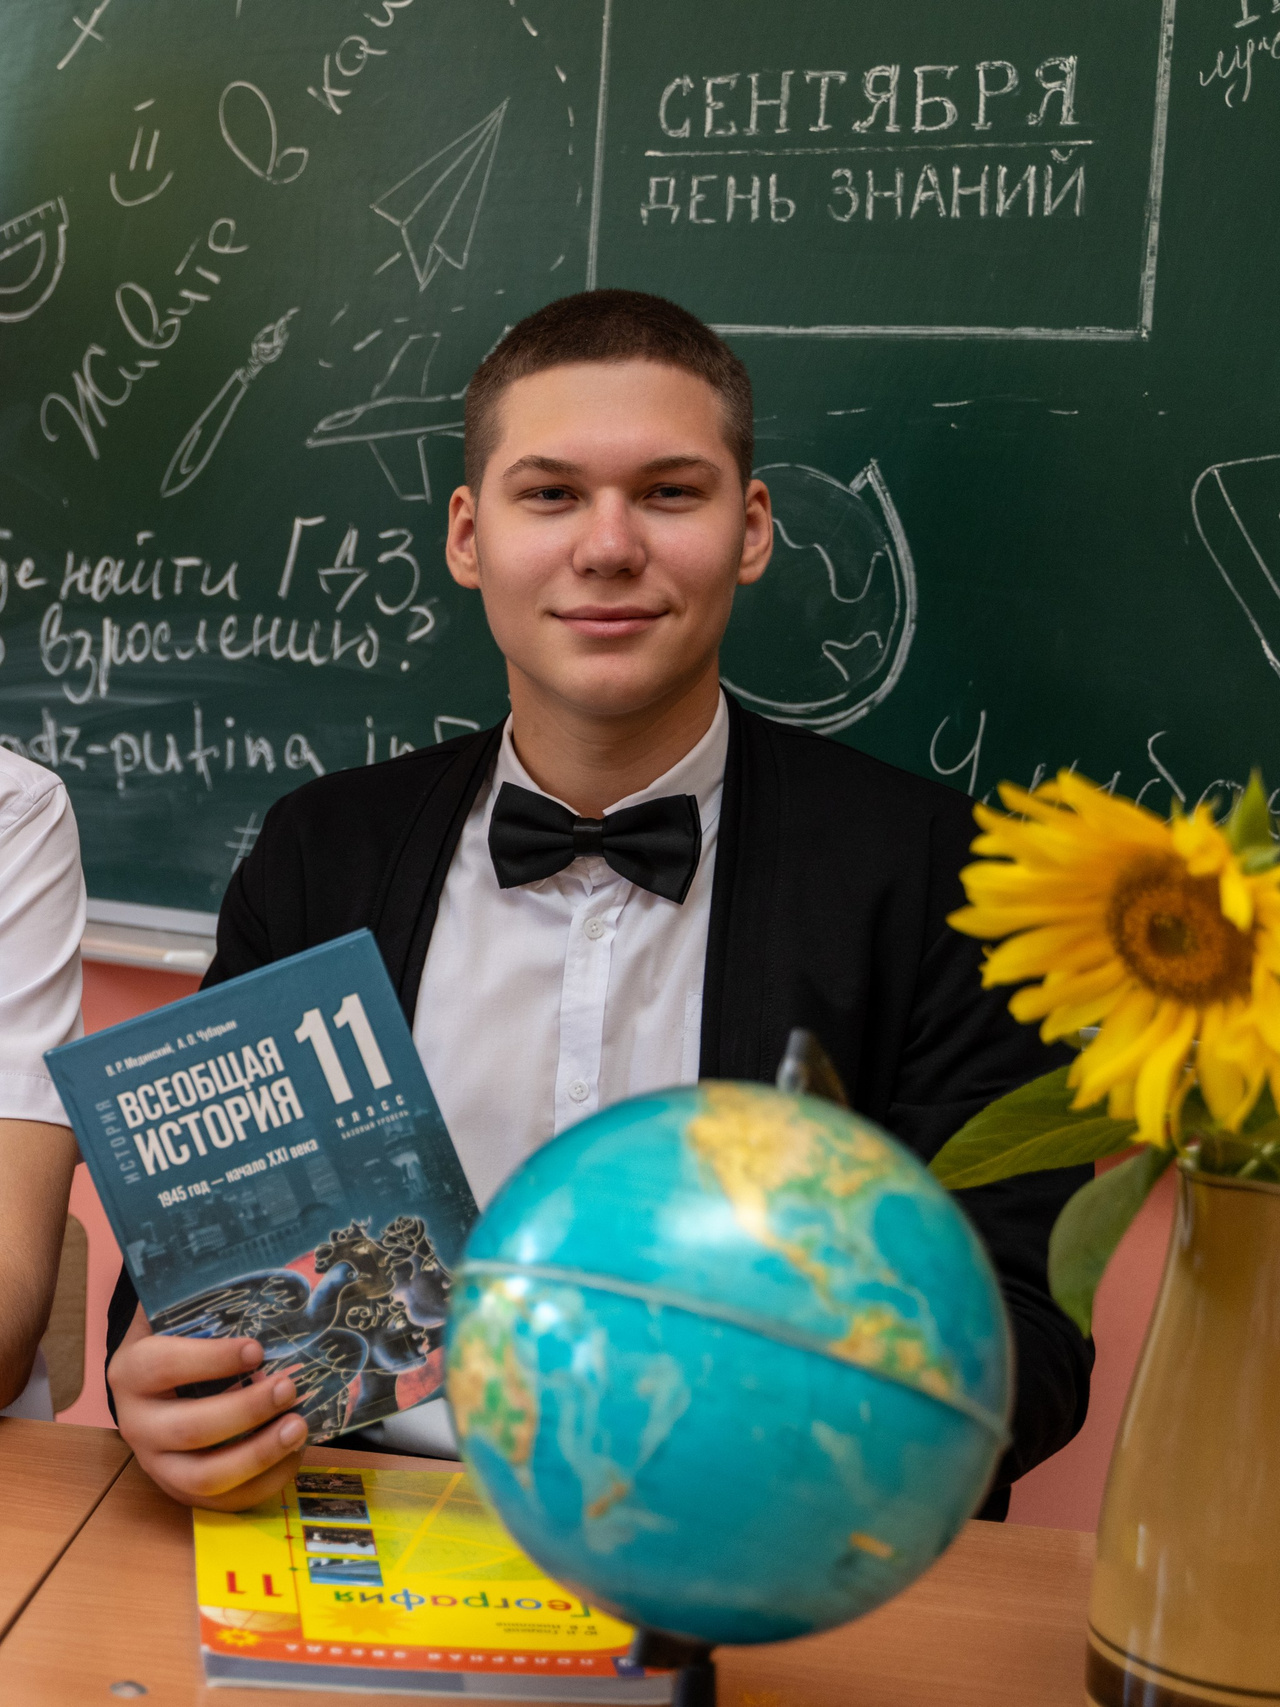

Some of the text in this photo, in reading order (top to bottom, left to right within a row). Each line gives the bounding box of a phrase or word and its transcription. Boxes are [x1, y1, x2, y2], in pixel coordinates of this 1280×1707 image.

[658, 54, 1079, 139] СЕНТЯБРЯ
[640, 146, 1087, 226] ДЕНЬ ЗНАНИЙ
[59, 530, 241, 603] найти
[277, 514, 421, 615] ГДЗ
[117, 1037, 284, 1128] ВСЕОБЩАЯ
[295, 994, 391, 1104] 11
[134, 1077, 303, 1175] ИСТОРИЯ
[157, 1185, 188, 1208] 1945
[187, 1180, 211, 1198] год
[225, 1158, 267, 1183] начало
[289, 1138, 319, 1159] века
[226, 1571, 282, 1597] 11
[333, 1589, 592, 1617] География
